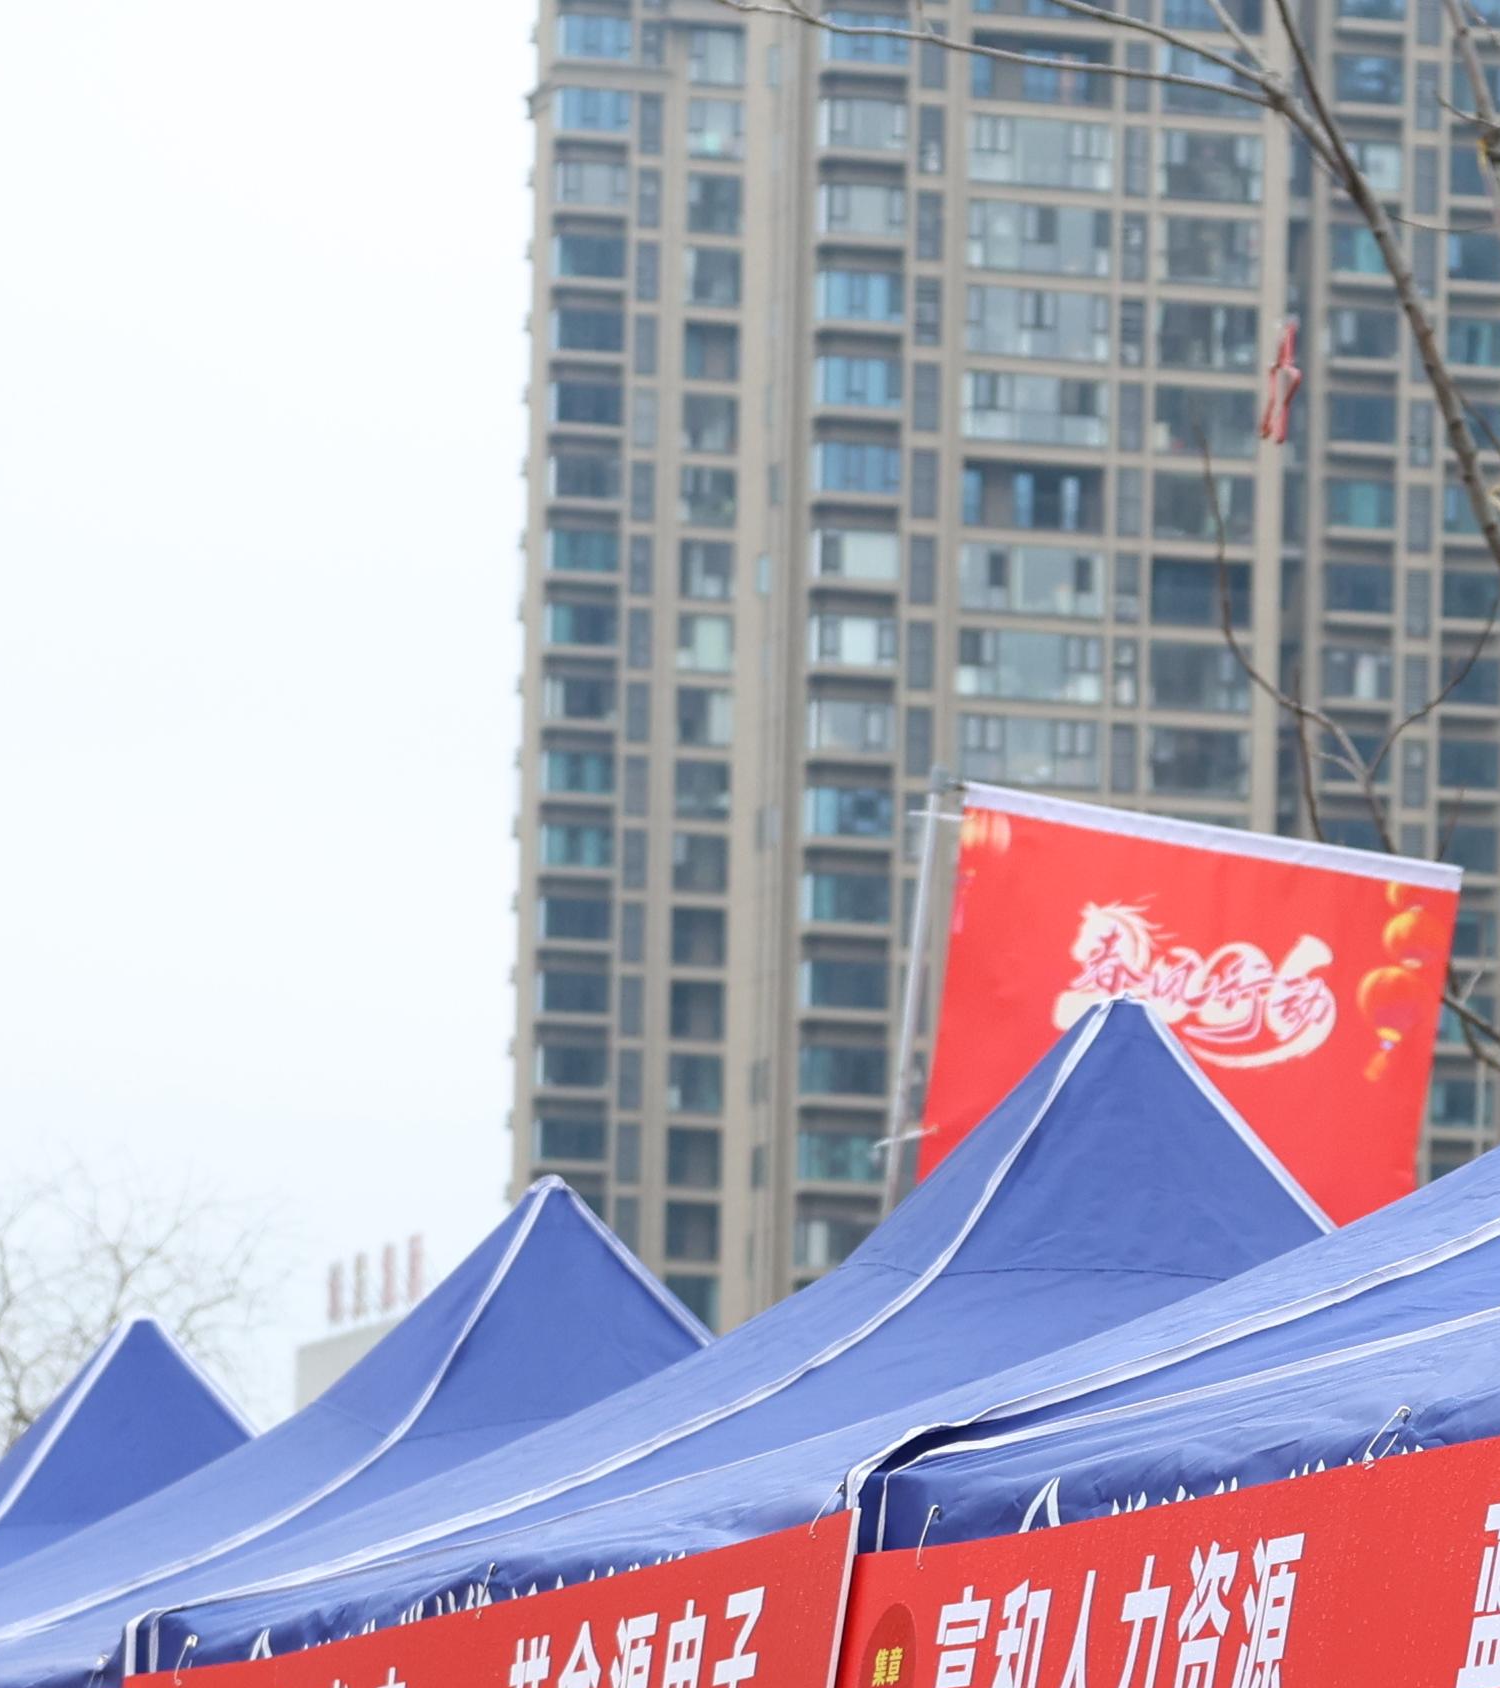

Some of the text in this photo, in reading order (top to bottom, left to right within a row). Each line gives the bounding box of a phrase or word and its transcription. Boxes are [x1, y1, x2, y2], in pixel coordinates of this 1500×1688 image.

[1071, 929, 1332, 1047] 春风行动
[871, 1646, 904, 1687] 集章
